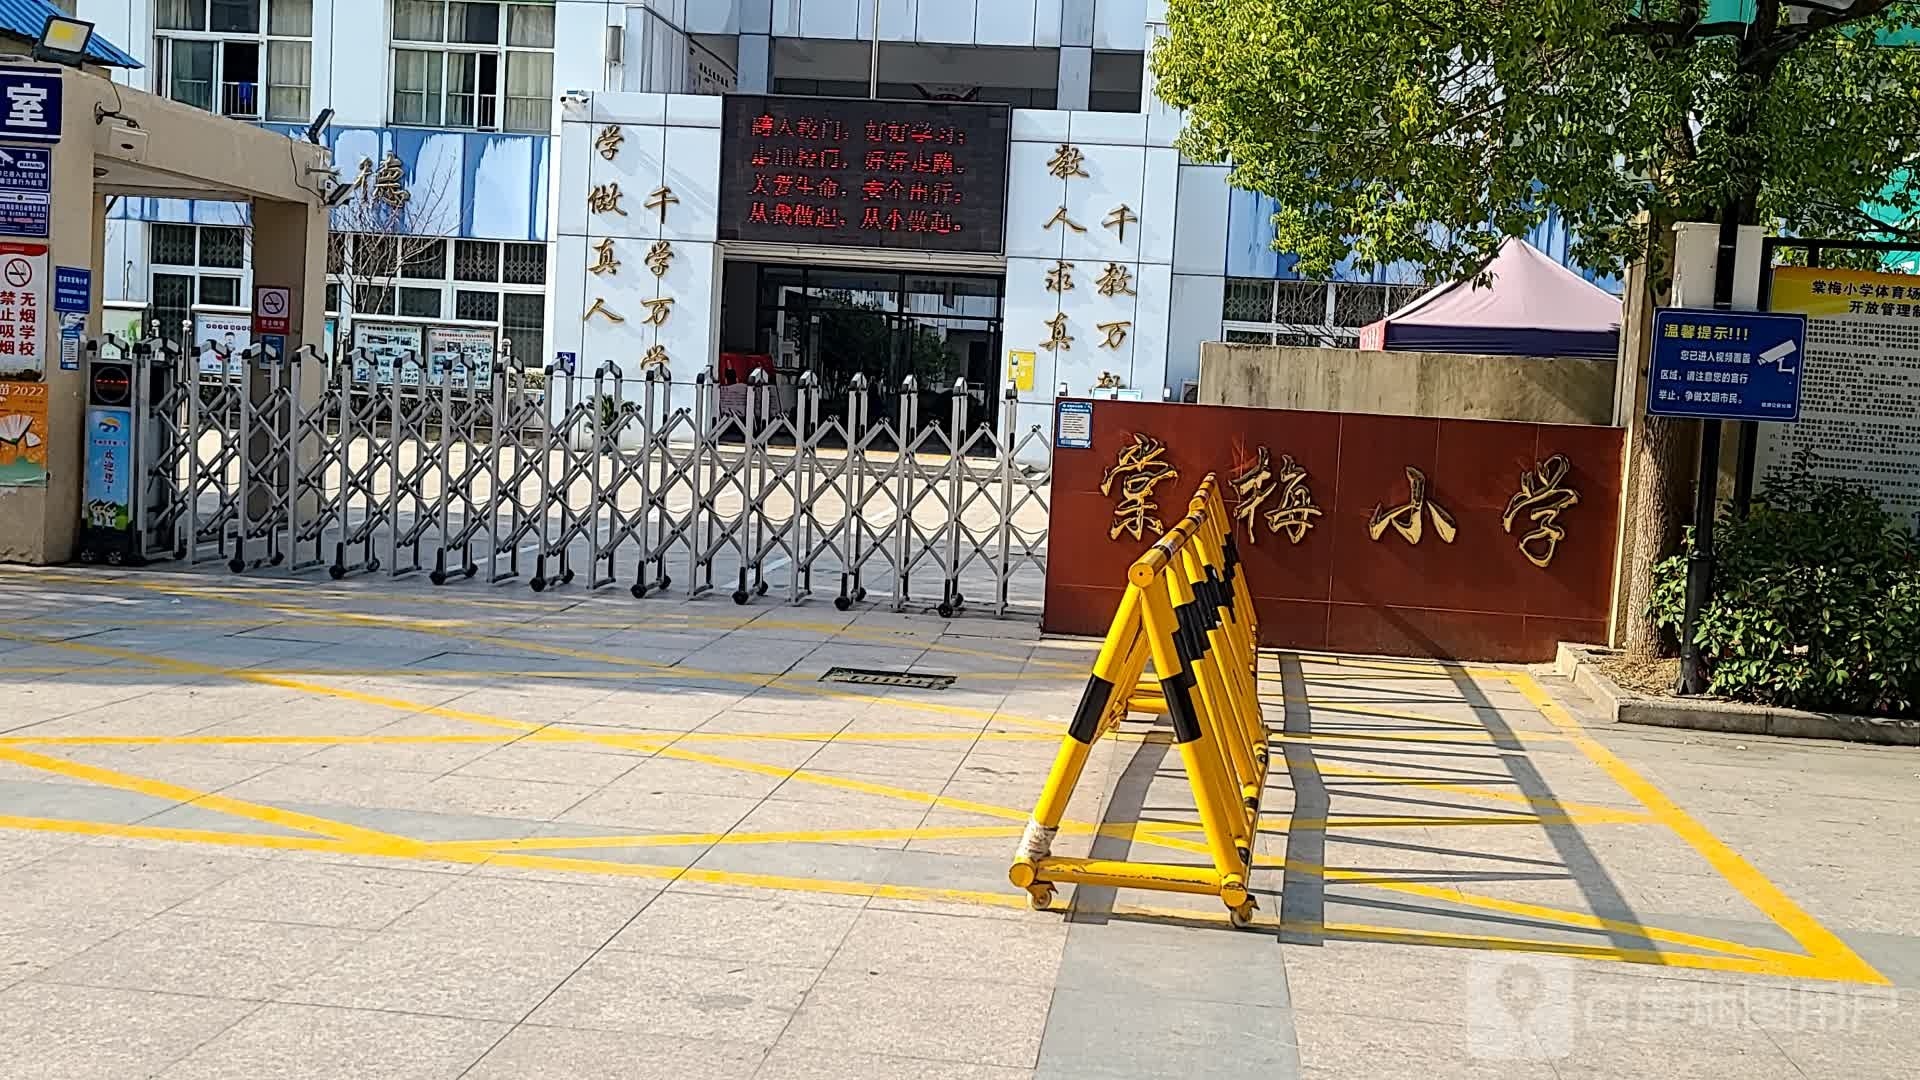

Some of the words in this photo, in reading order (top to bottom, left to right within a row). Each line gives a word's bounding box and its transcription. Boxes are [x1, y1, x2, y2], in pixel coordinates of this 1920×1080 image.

[5, 82, 48, 128] 室
[583, 124, 628, 323] 学做真人
[1038, 144, 1090, 352] 教人求真
[1812, 280, 1920, 300] 棠梅小学体育场
[19, 292, 36, 356] 无烟学校
[13, 386, 44, 397] 2022
[1100, 431, 1582, 568] 棠梅小学
